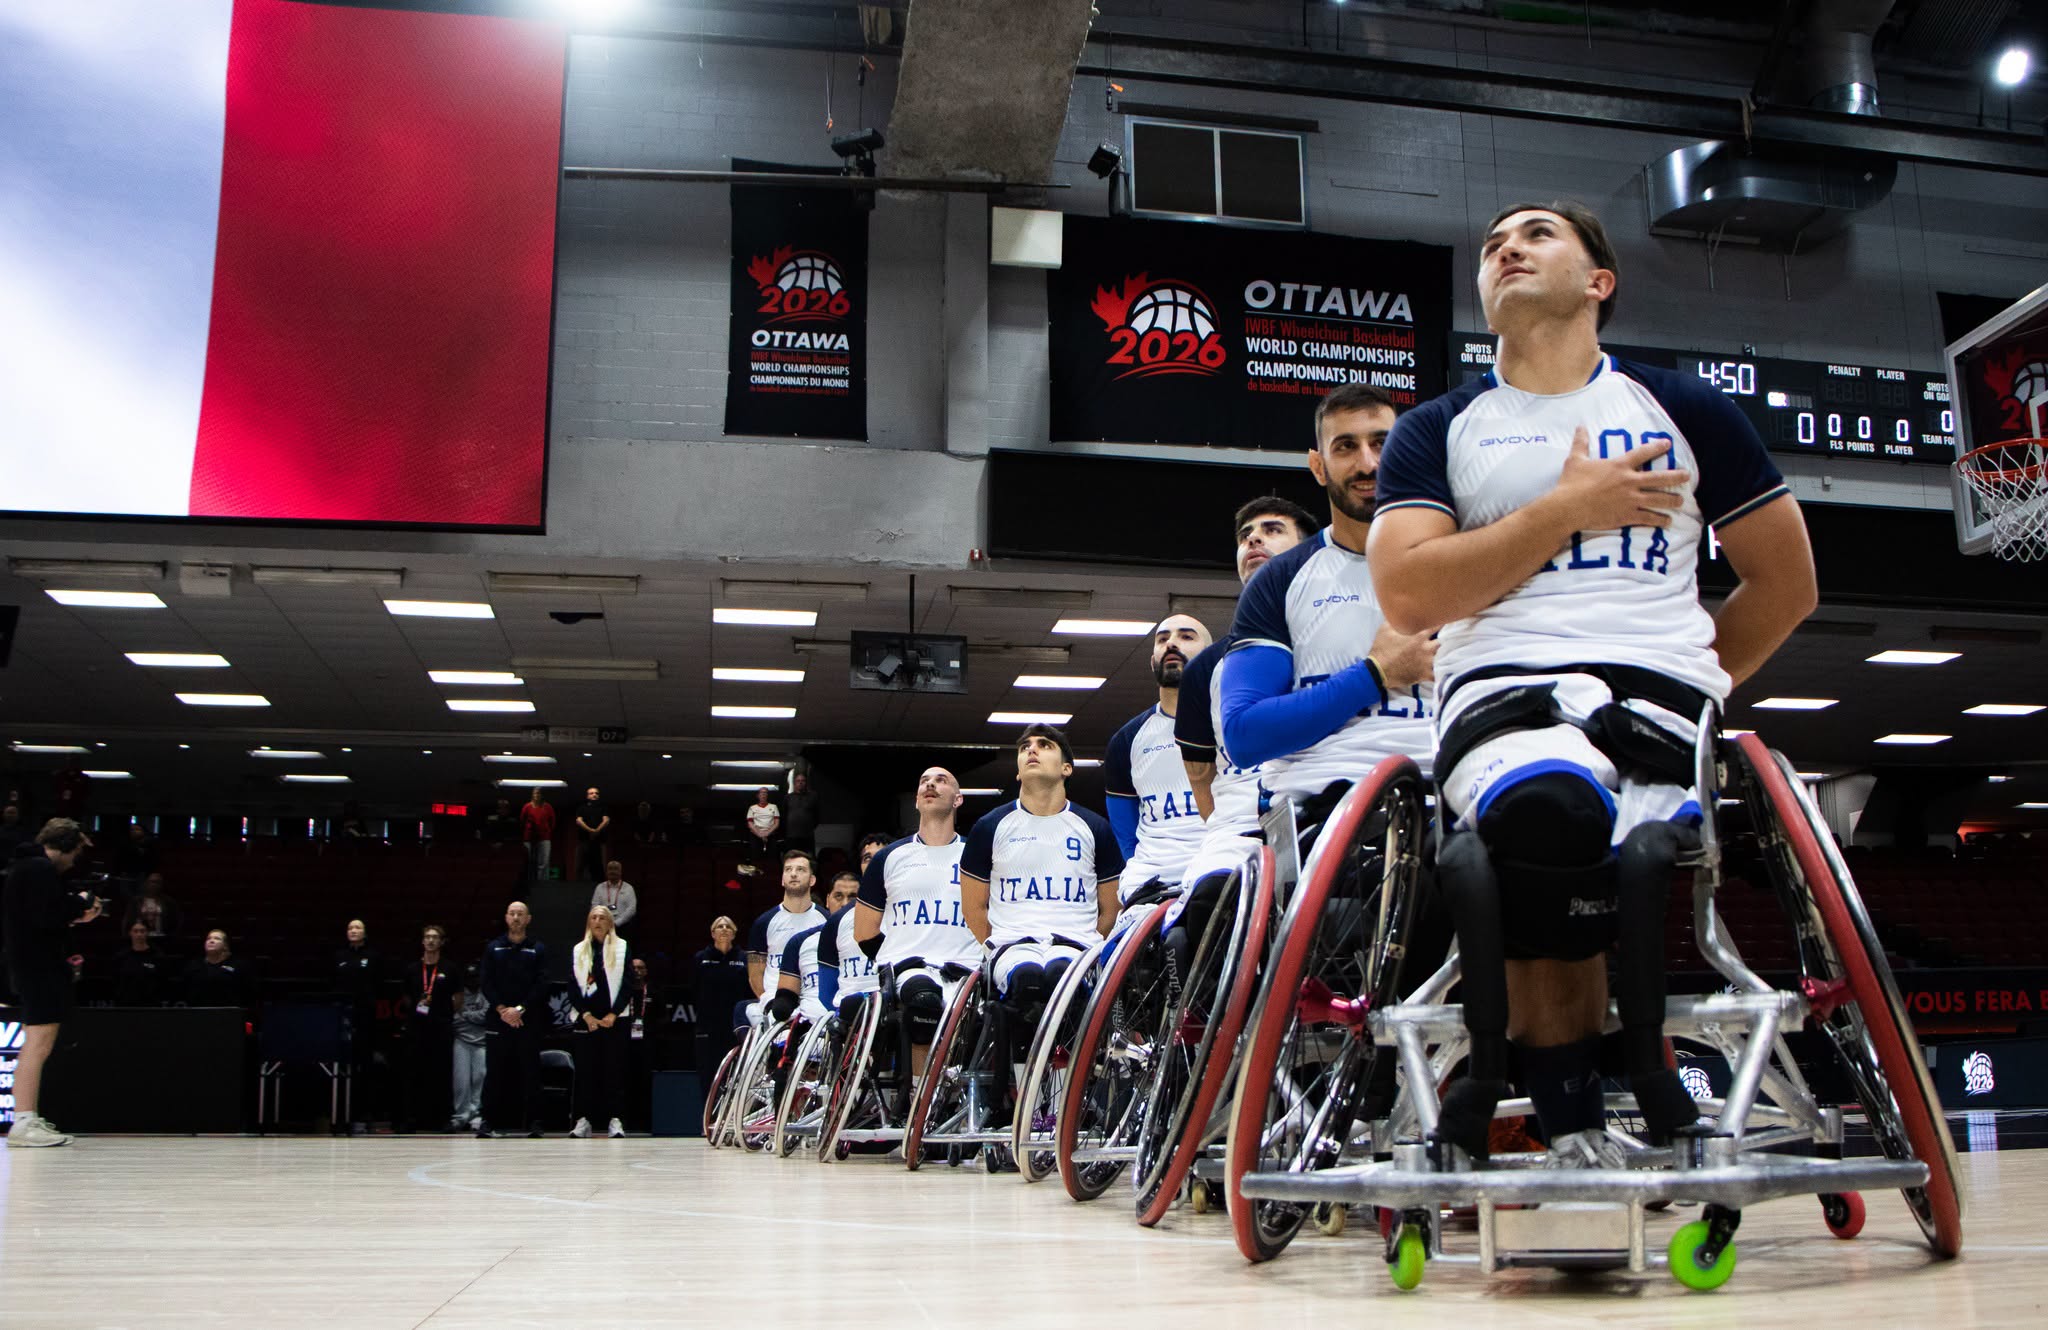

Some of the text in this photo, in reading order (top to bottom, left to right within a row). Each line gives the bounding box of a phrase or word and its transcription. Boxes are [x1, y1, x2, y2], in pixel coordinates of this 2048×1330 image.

[757, 286, 850, 316] 2026
[1244, 280, 1414, 322] OTTAWA
[751, 329, 849, 351] OTTAWA
[1245, 317, 1415, 349] IWBF Wheelchair Basketball
[1106, 328, 1227, 368] 2026
[1246, 337, 1416, 368] WORLD CHAMPIONSHIPS
[1461, 352, 1496, 365] ON GOAL
[1465, 342, 1492, 355] SHOTS
[751, 361, 850, 376] WORLD CHAMPIONSHIPS
[1246, 361, 1416, 391] CHAMPIONNATS DU MONDE
[1698, 361, 1755, 395] 4:50
[1828, 365, 1861, 378] PENALTY
[1877, 369, 1905, 382] PLAYER
[750, 375, 849, 389] CHAMPIONNATS DU MONDE
[1259, 377, 1299, 394] basketball
[1923, 391, 1934, 401] ON
[1797, 412, 1814, 444] 0
[1827, 413, 1841, 437] 0
[1858, 416, 1871, 439] 0
[1896, 419, 1909, 442] 0
[1941, 410, 1955, 433] 0
[1479, 435, 1548, 448] GIVOVA
[1830, 439, 1844, 451] FLS
[1847, 440, 1875, 453] POINTS
[1884, 444, 1914, 456] PLAYER
[1921, 434, 1942, 445] TEAM
[1066, 836, 1082, 861] 9
[1000, 876, 1087, 903] ITALIA
[1975, 989, 2033, 1012] FERA
[1964, 1074, 1995, 1092] 2026
